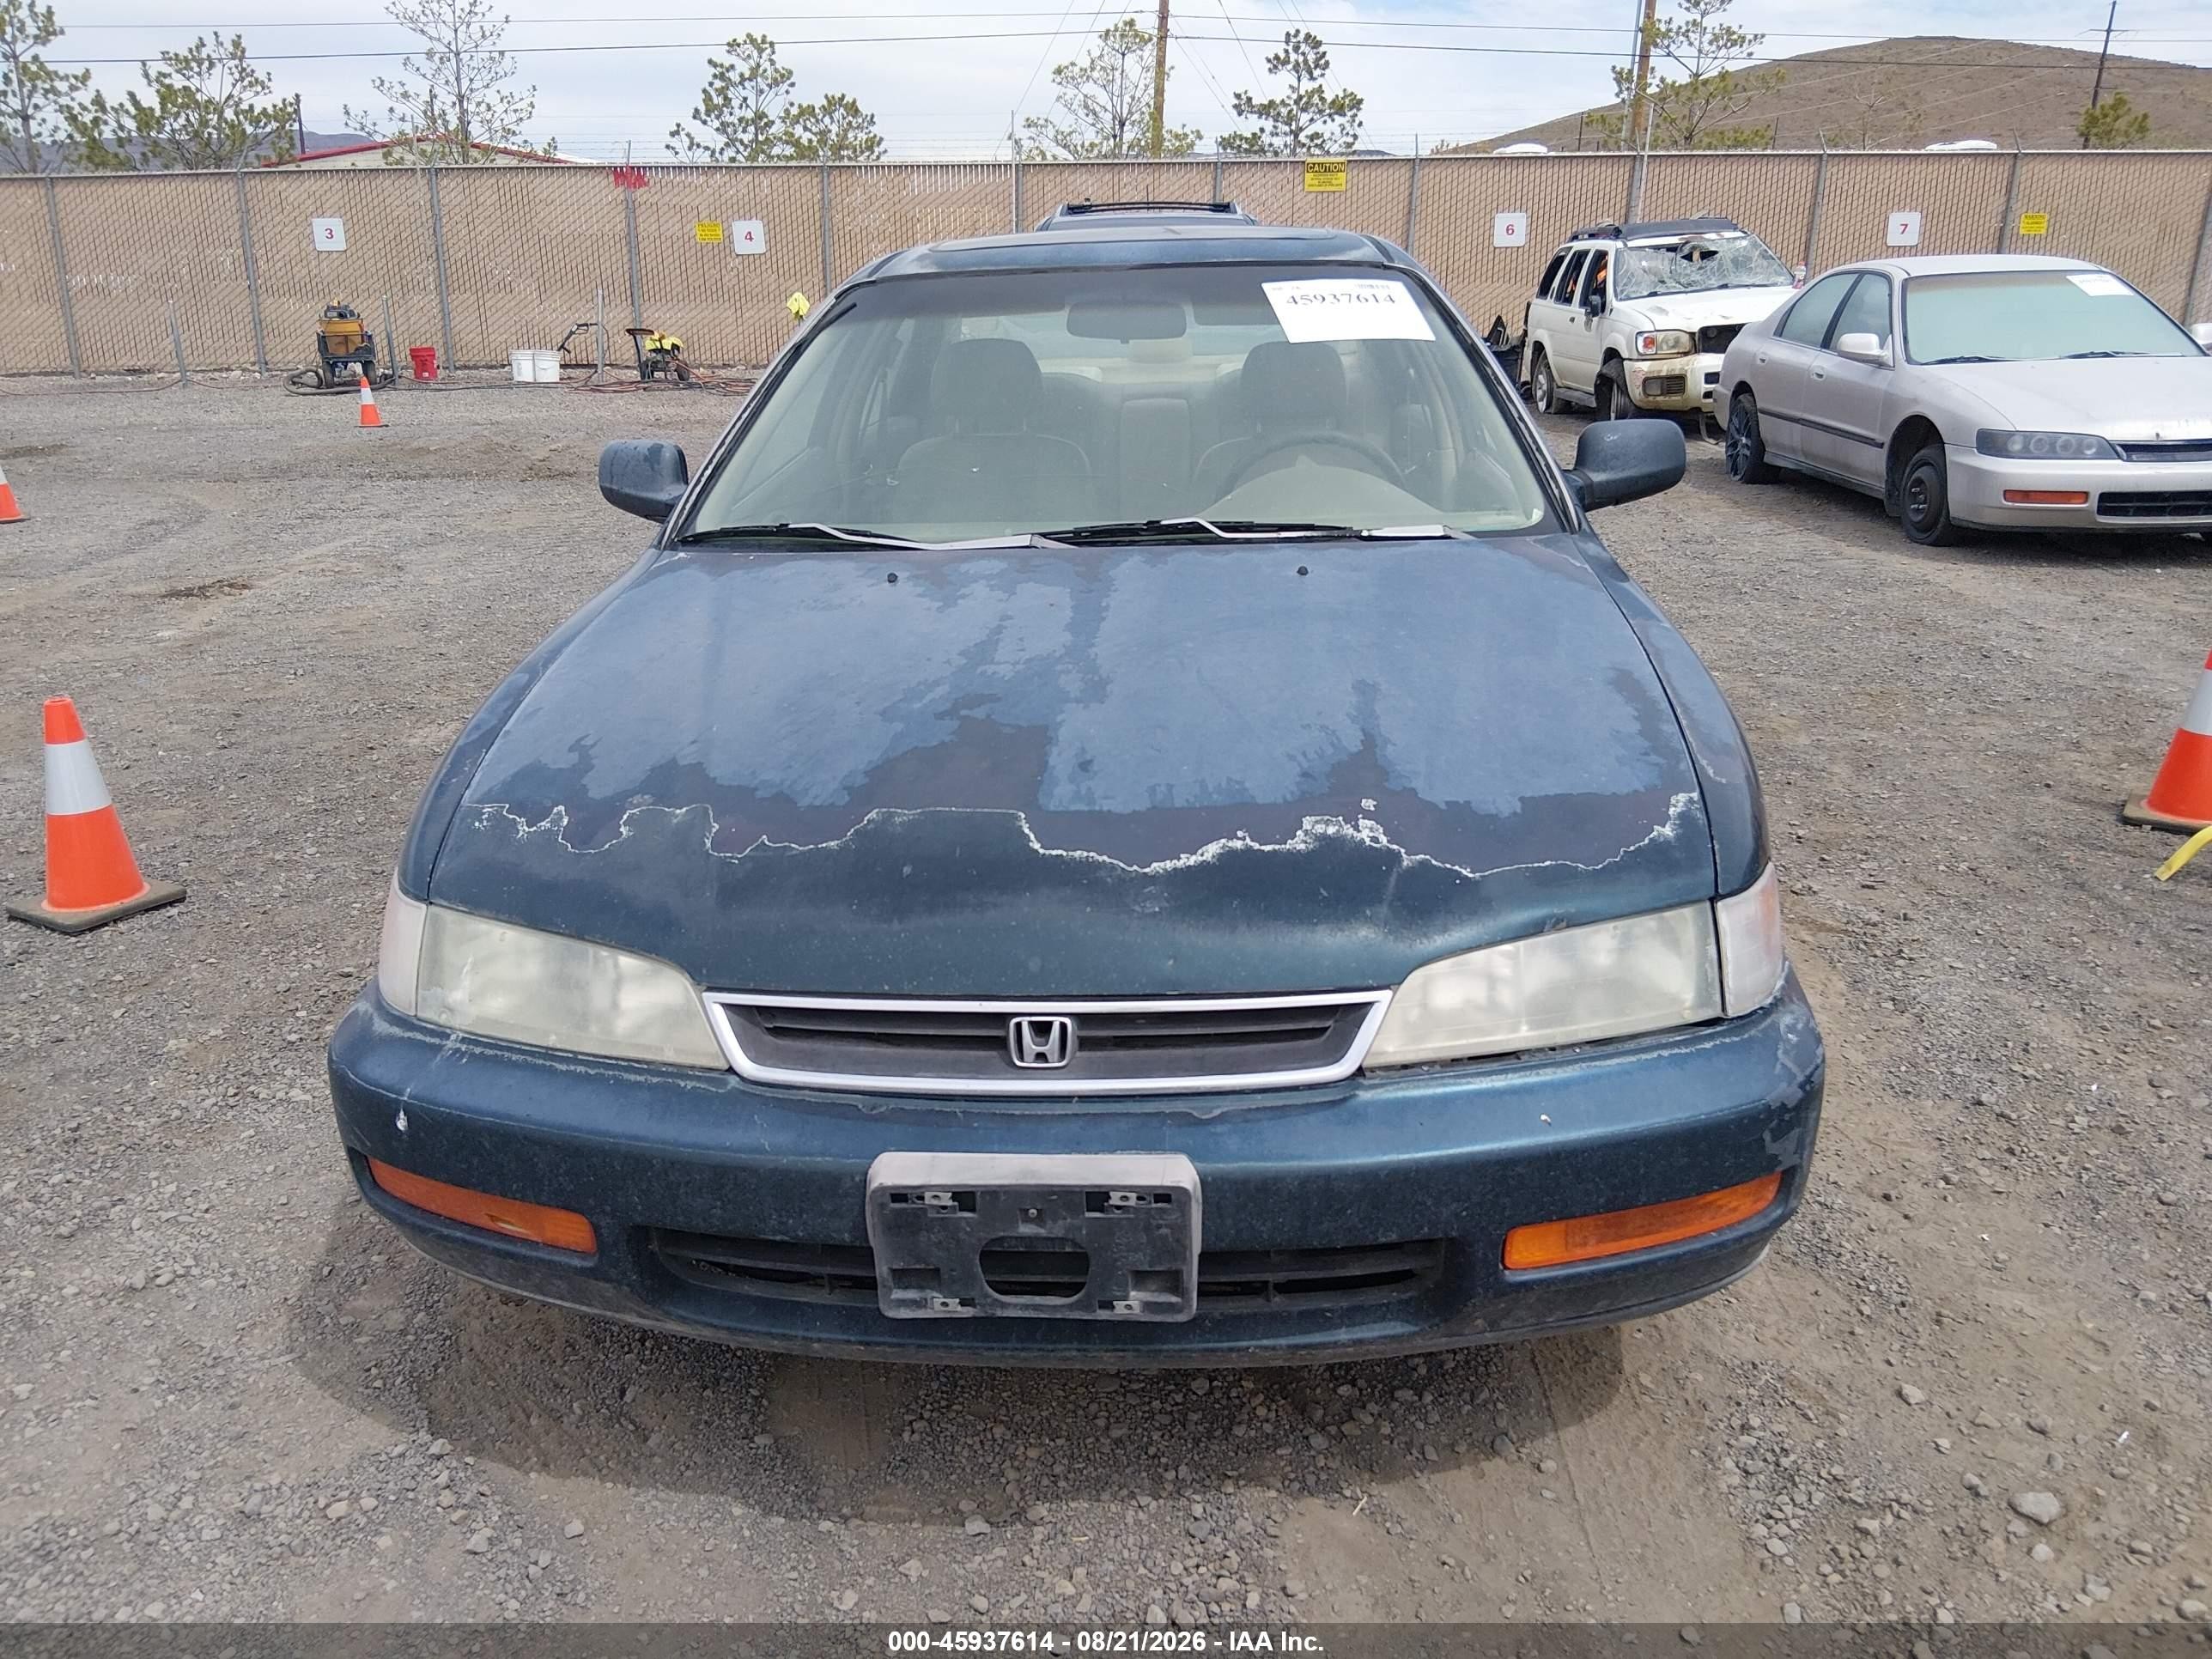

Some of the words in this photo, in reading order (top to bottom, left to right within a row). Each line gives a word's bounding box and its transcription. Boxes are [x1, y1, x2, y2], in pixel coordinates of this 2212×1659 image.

[1308, 163, 1345, 173] CAUTION
[325, 228, 334, 240] 3
[1505, 224, 1515, 235] 6
[1899, 223, 1909, 234] 7
[744, 231, 755, 242] 4
[1285, 293, 1396, 306] 45937614
